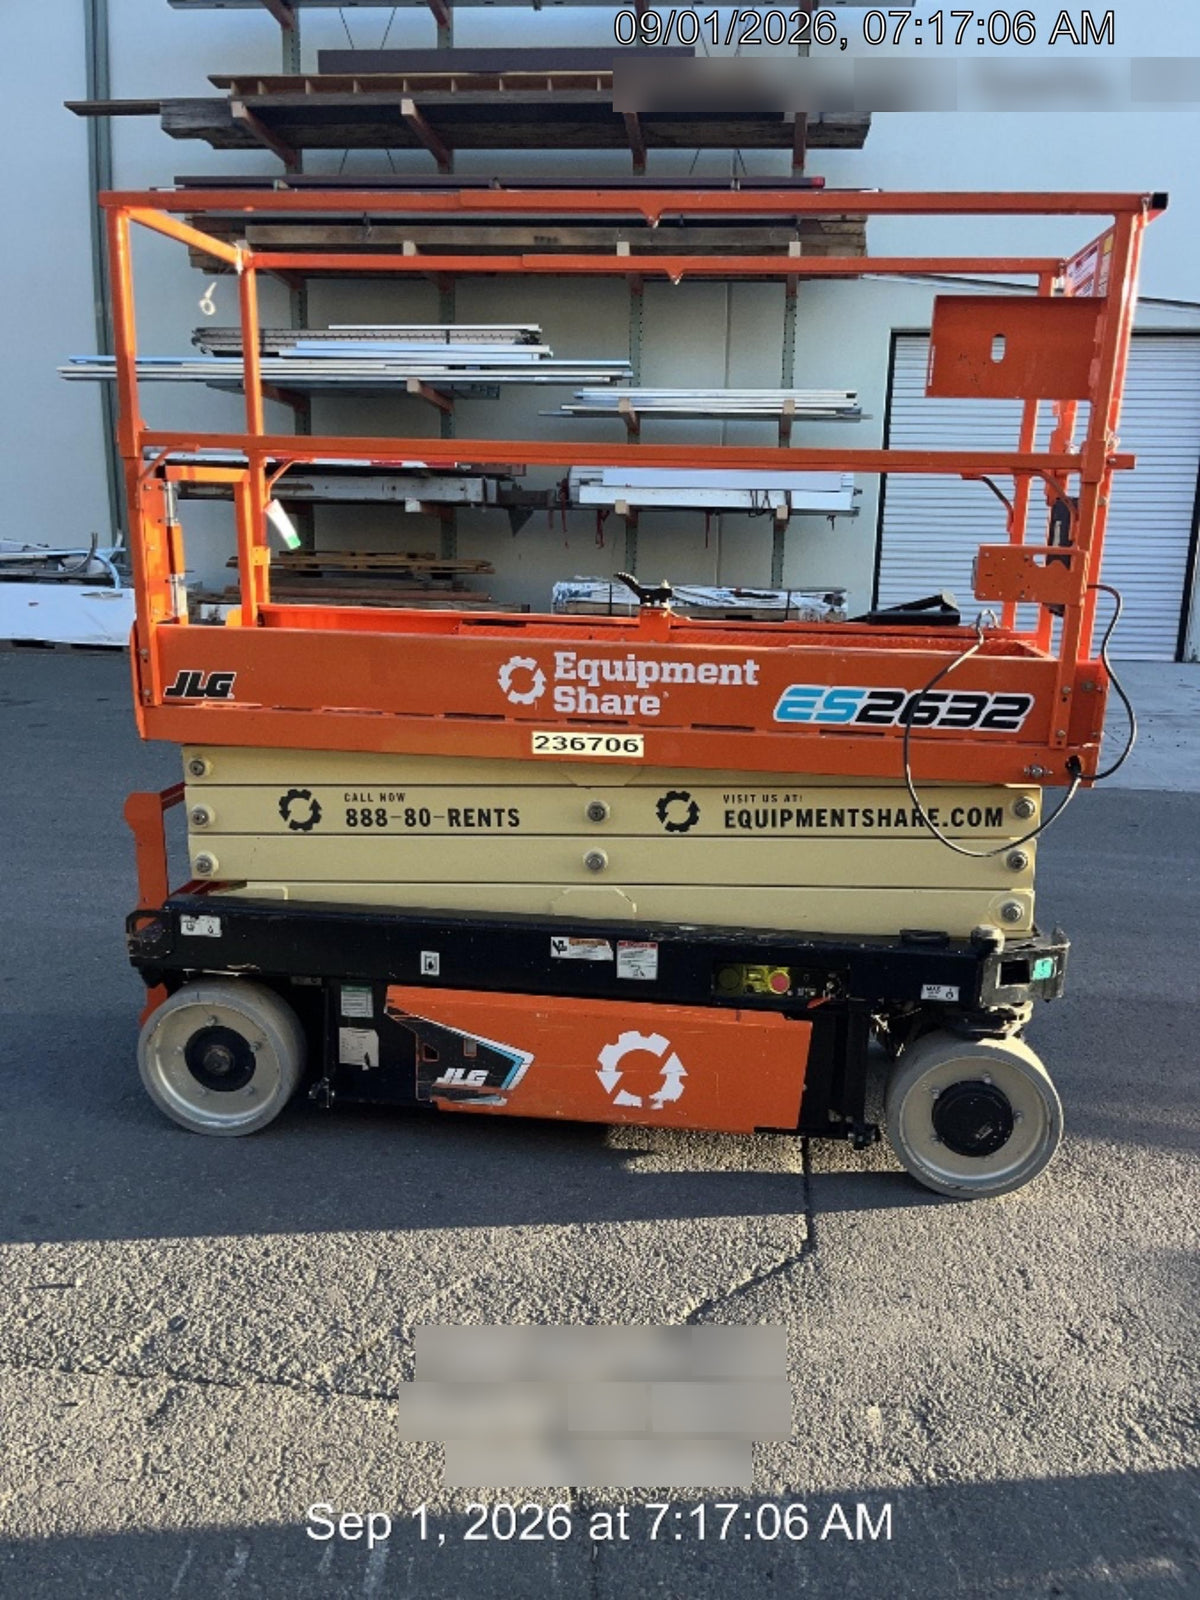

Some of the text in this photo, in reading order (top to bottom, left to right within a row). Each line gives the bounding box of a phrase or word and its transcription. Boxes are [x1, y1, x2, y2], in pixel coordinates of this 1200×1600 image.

[553, 651, 760, 689] Equipment
[163, 669, 235, 700] JLG
[553, 685, 661, 716] Share
[772, 684, 1035, 733] ES2632
[534, 734, 640, 753] 236706
[343, 792, 406, 802] CALL NOW
[722, 794, 757, 804] VISIT
[762, 794, 778, 803] US
[345, 807, 521, 828] 888-80-RENTS
[724, 806, 1004, 830] EQUIPMENTSHARE.COM
[431, 1067, 490, 1087] JLG
